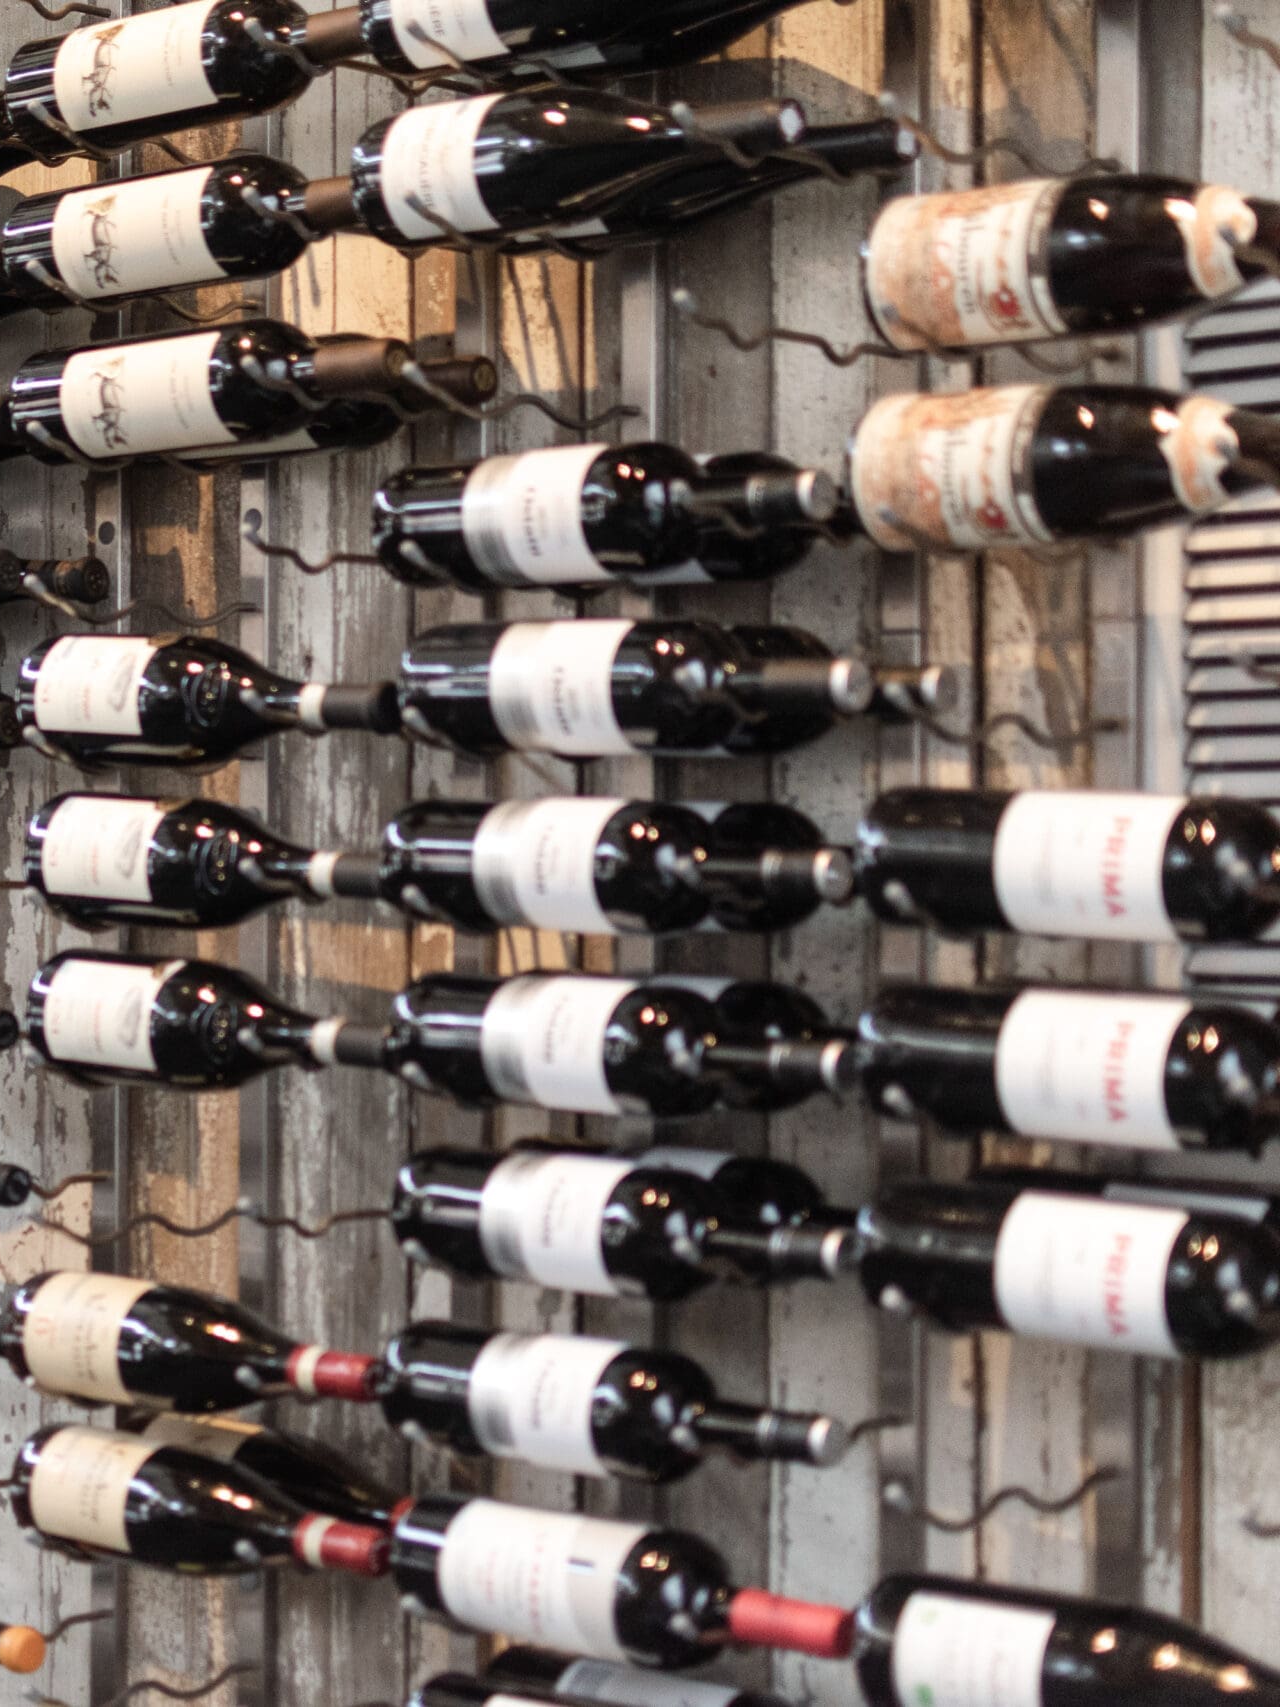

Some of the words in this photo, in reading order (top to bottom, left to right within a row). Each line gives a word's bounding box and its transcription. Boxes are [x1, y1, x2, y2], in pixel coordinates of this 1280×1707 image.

[1104, 816, 1133, 918] PRIMA
[1104, 1021, 1135, 1121] PRIMA
[1104, 1234, 1132, 1334] PRIMA
